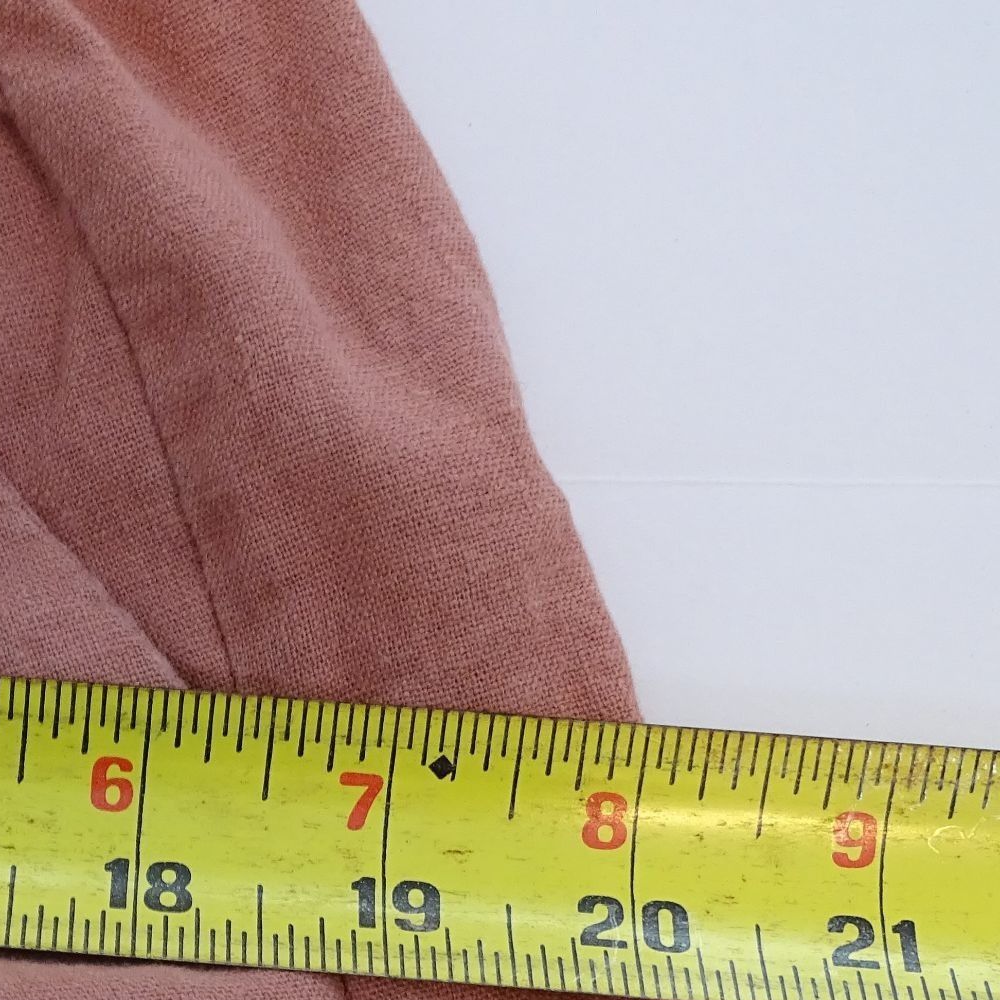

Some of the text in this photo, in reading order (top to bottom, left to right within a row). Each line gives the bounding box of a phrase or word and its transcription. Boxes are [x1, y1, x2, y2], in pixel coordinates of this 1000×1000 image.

[90, 757, 134, 812] 6
[339, 772, 384, 830] 7
[581, 792, 628, 850] 8
[832, 811, 877, 869] 9
[104, 858, 192, 913] 18
[351, 877, 441, 932] 19
[577, 895, 690, 953] 20
[827, 915, 921, 973] 21
